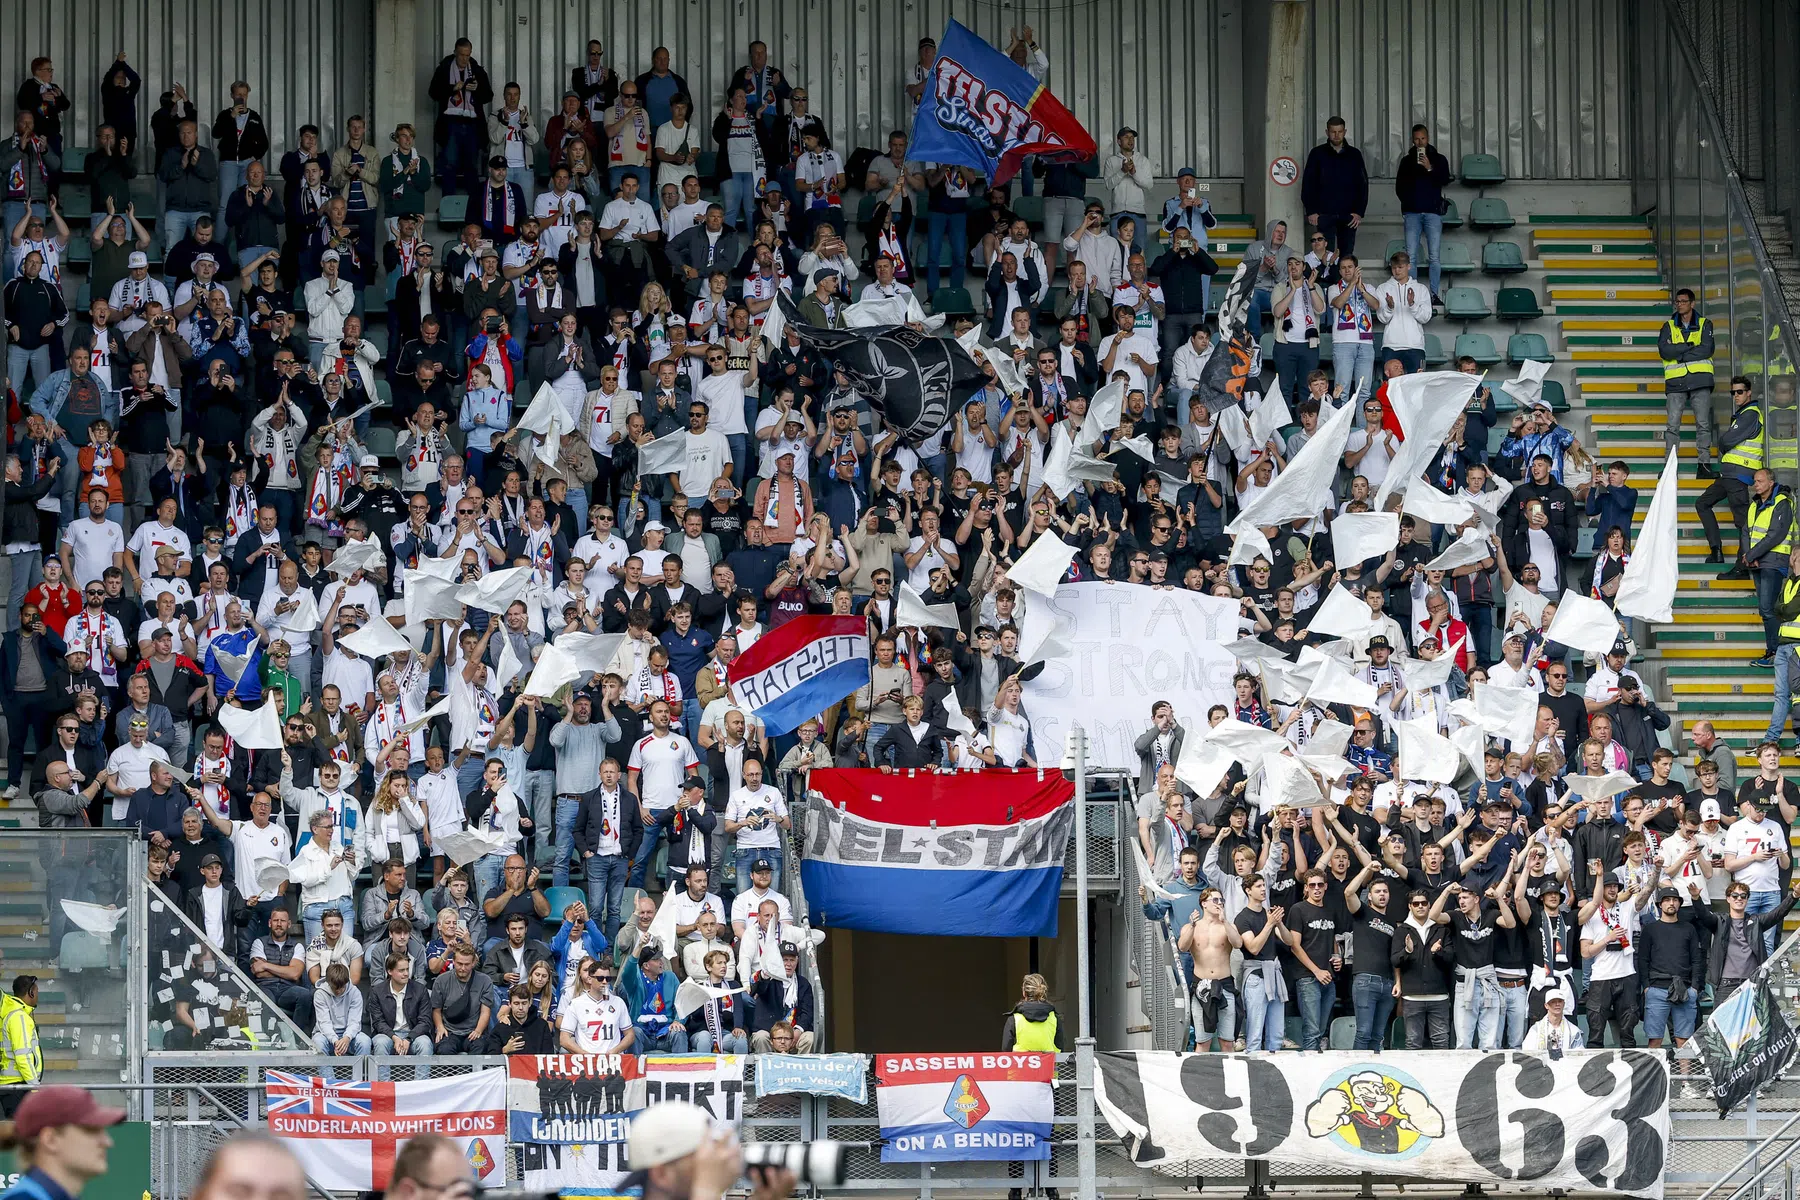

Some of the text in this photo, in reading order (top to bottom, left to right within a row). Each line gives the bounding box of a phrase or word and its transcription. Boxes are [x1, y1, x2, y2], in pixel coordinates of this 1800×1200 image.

[938, 58, 1064, 147] TELST
[1606, 290, 1615, 298] 20
[91, 349, 112, 367] 711
[418, 447, 437, 463] 711
[1699, 580, 1708, 588] 14
[777, 601, 804, 612] BUKO
[1046, 588, 1227, 641] STAY
[1715, 632, 1725, 640] 13
[1614, 642, 1625, 650] 63
[1034, 640, 1234, 699] STRONG
[1732, 684, 1742, 692] 12
[785, 943, 795, 951] 63
[587, 1020, 614, 1042] 711
[534, 1053, 622, 1077] TELSTAR
[886, 1054, 1042, 1074] SASSEM BOYS
[1752, 1051, 1768, 1067] on
[808, 1075, 849, 1087] Velsen
[296, 1086, 340, 1099] TELSTAR
[954, 1101, 978, 1109] TELSTAR
[273, 1115, 496, 1134] SUNDERLAND WHITE LIONS
[1093, 1050, 1668, 1191] 19 63
[895, 1131, 1036, 1152] ON A BENDER
